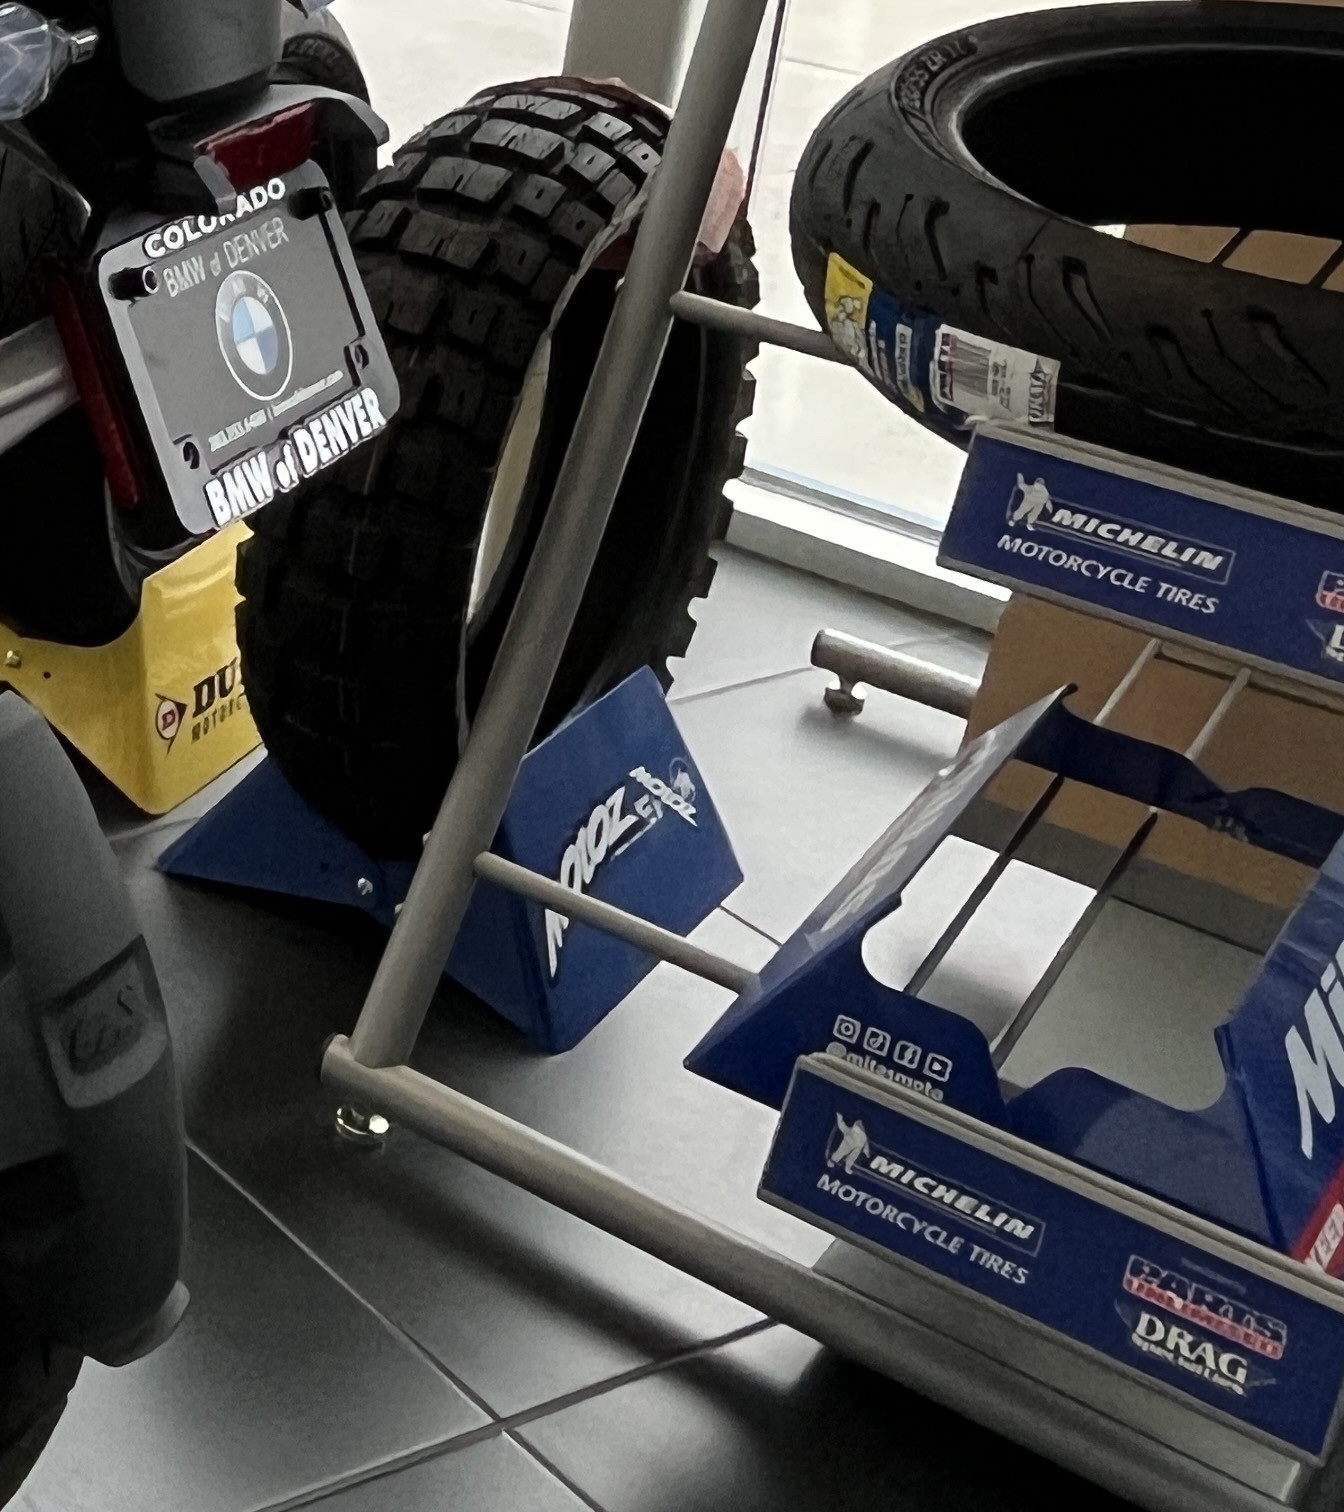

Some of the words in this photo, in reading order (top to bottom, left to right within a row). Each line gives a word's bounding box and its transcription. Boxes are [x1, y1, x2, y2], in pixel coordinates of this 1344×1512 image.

[164, 255, 206, 297] BMW
[223, 217, 290, 268] DENVER
[205, 450, 274, 526] BMW
[275, 443, 299, 488] of
[293, 387, 387, 473] DENVER
[997, 534, 1152, 593] MOTORCYCLE
[1156, 581, 1219, 614] TIRES
[1052, 508, 1224, 570] MICHELIN
[816, 1173, 966, 1255] MOTORCYCLE
[969, 1243, 1030, 1285] TIRES
[870, 1155, 1035, 1239] MICHELIN
[1135, 1310, 1249, 1385] DRAG
